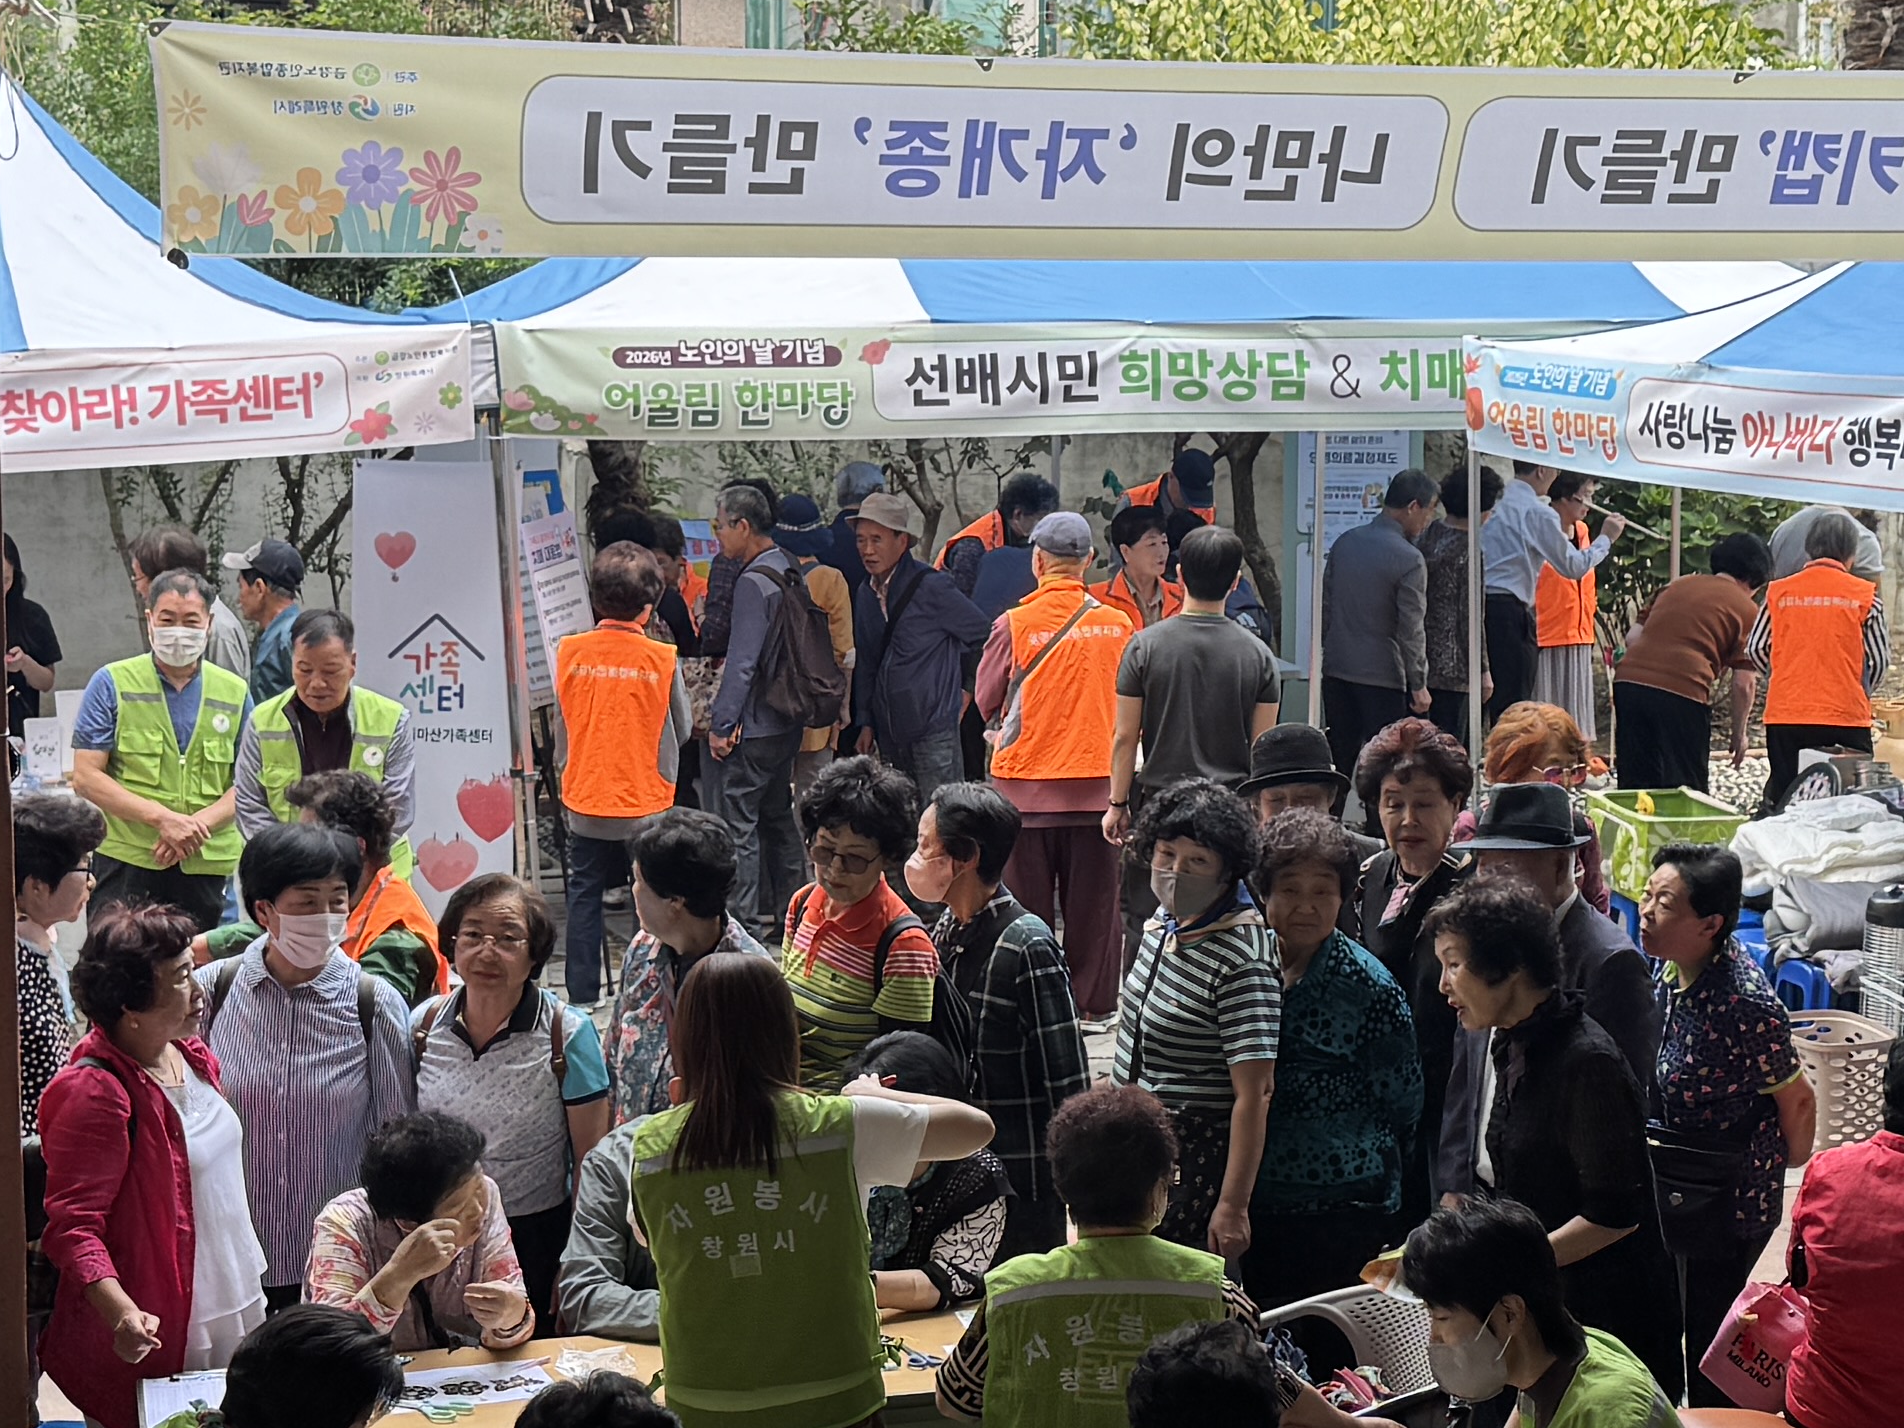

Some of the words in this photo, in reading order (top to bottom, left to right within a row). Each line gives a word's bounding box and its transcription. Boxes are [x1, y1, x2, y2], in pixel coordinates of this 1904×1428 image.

[624, 349, 672, 370] 2026년
[676, 339, 747, 367] 노인의
[750, 338, 777, 366] 날
[781, 338, 826, 364] 기념
[903, 348, 1100, 408] 선배시민
[1117, 348, 1311, 404] 희망상담
[1328, 358, 1364, 401] &
[1529, 362, 1568, 390] 노인의
[1567, 366, 1585, 394] 날
[1584, 367, 1612, 397] 기념
[601, 379, 721, 432] 어울림
[732, 375, 856, 429] 한마당
[1487, 401, 1550, 453] 어울림
[1551, 407, 1619, 463] 한마당
[1638, 401, 1737, 457] 사랑나눔
[1741, 409, 1838, 466] 아나바다
[402, 640, 461, 686] 가족
[399, 674, 465, 714] 센터
[412, 726, 493, 744] 마산가족센터
[666, 1179, 829, 1235] 자원봉사
[701, 1228, 795, 1260] 창원시
